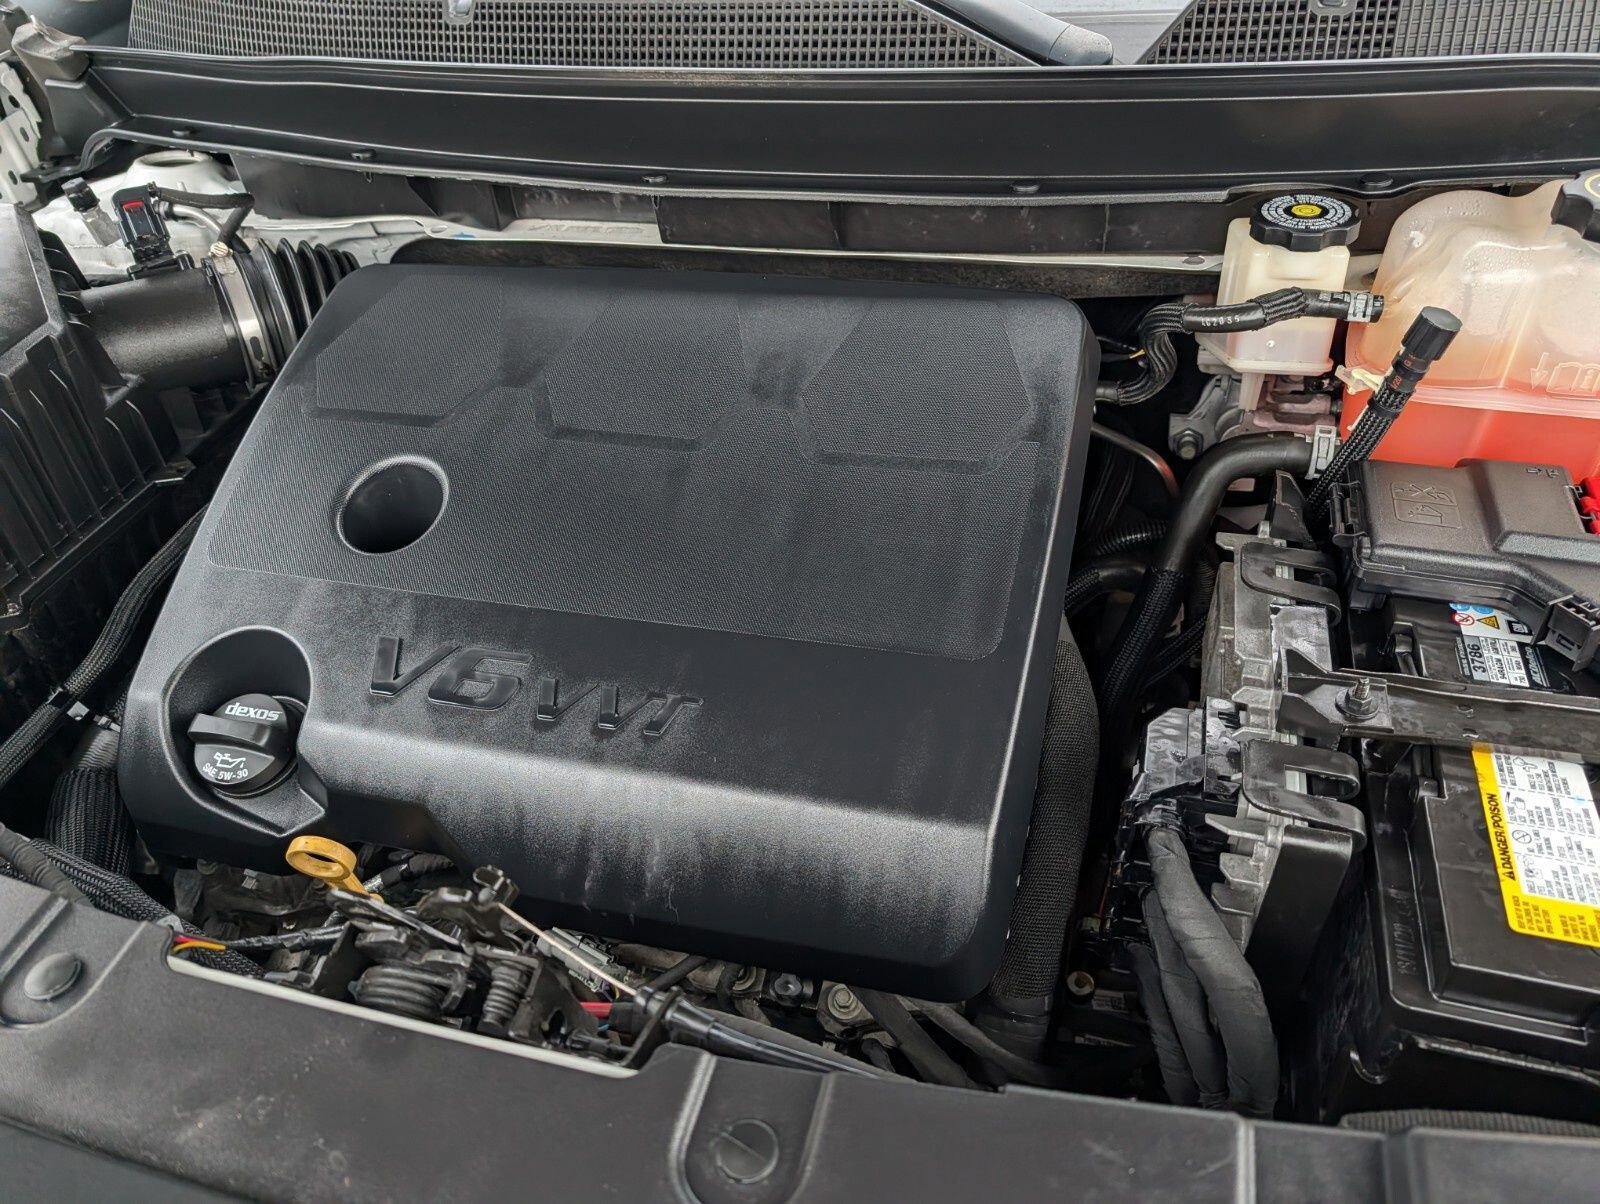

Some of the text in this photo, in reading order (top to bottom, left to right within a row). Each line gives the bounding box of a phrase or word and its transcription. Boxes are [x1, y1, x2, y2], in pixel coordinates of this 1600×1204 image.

[1466, 643, 1487, 673] 3786
[370, 636, 703, 736] V6 VVT
[225, 702, 282, 721] dexos
[202, 762, 249, 780] SAE 5W-30
[1486, 793, 1513, 870] DANGER/POISON
